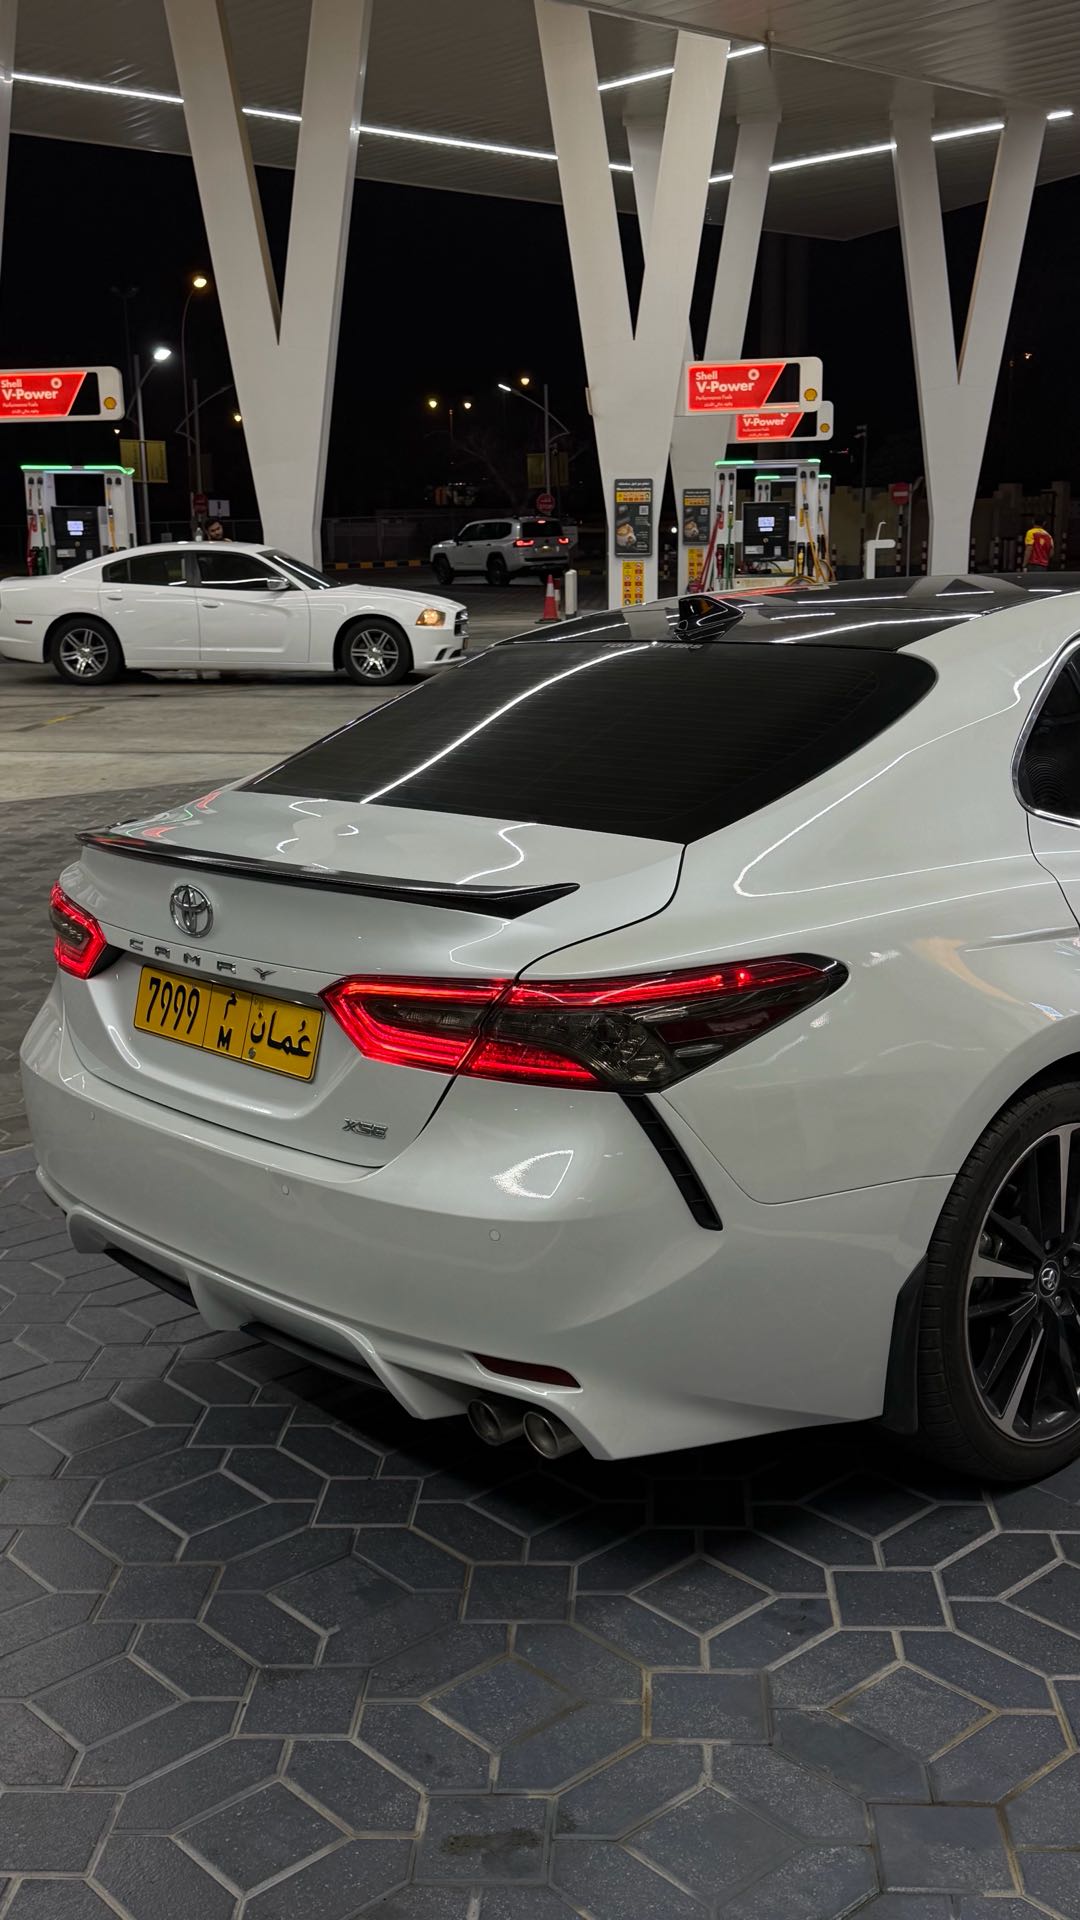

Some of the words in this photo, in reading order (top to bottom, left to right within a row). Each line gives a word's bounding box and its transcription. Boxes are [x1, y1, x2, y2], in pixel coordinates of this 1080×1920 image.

[695, 371, 718, 380] Shell
[1, 379, 22, 389] Shell
[696, 381, 755, 393] V-Power
[2, 388, 58, 400] V-Power
[743, 417, 785, 427] V-Power
[129, 938, 277, 981] CAMRY
[146, 976, 200, 1034] 7999
[216, 1025, 233, 1051] M
